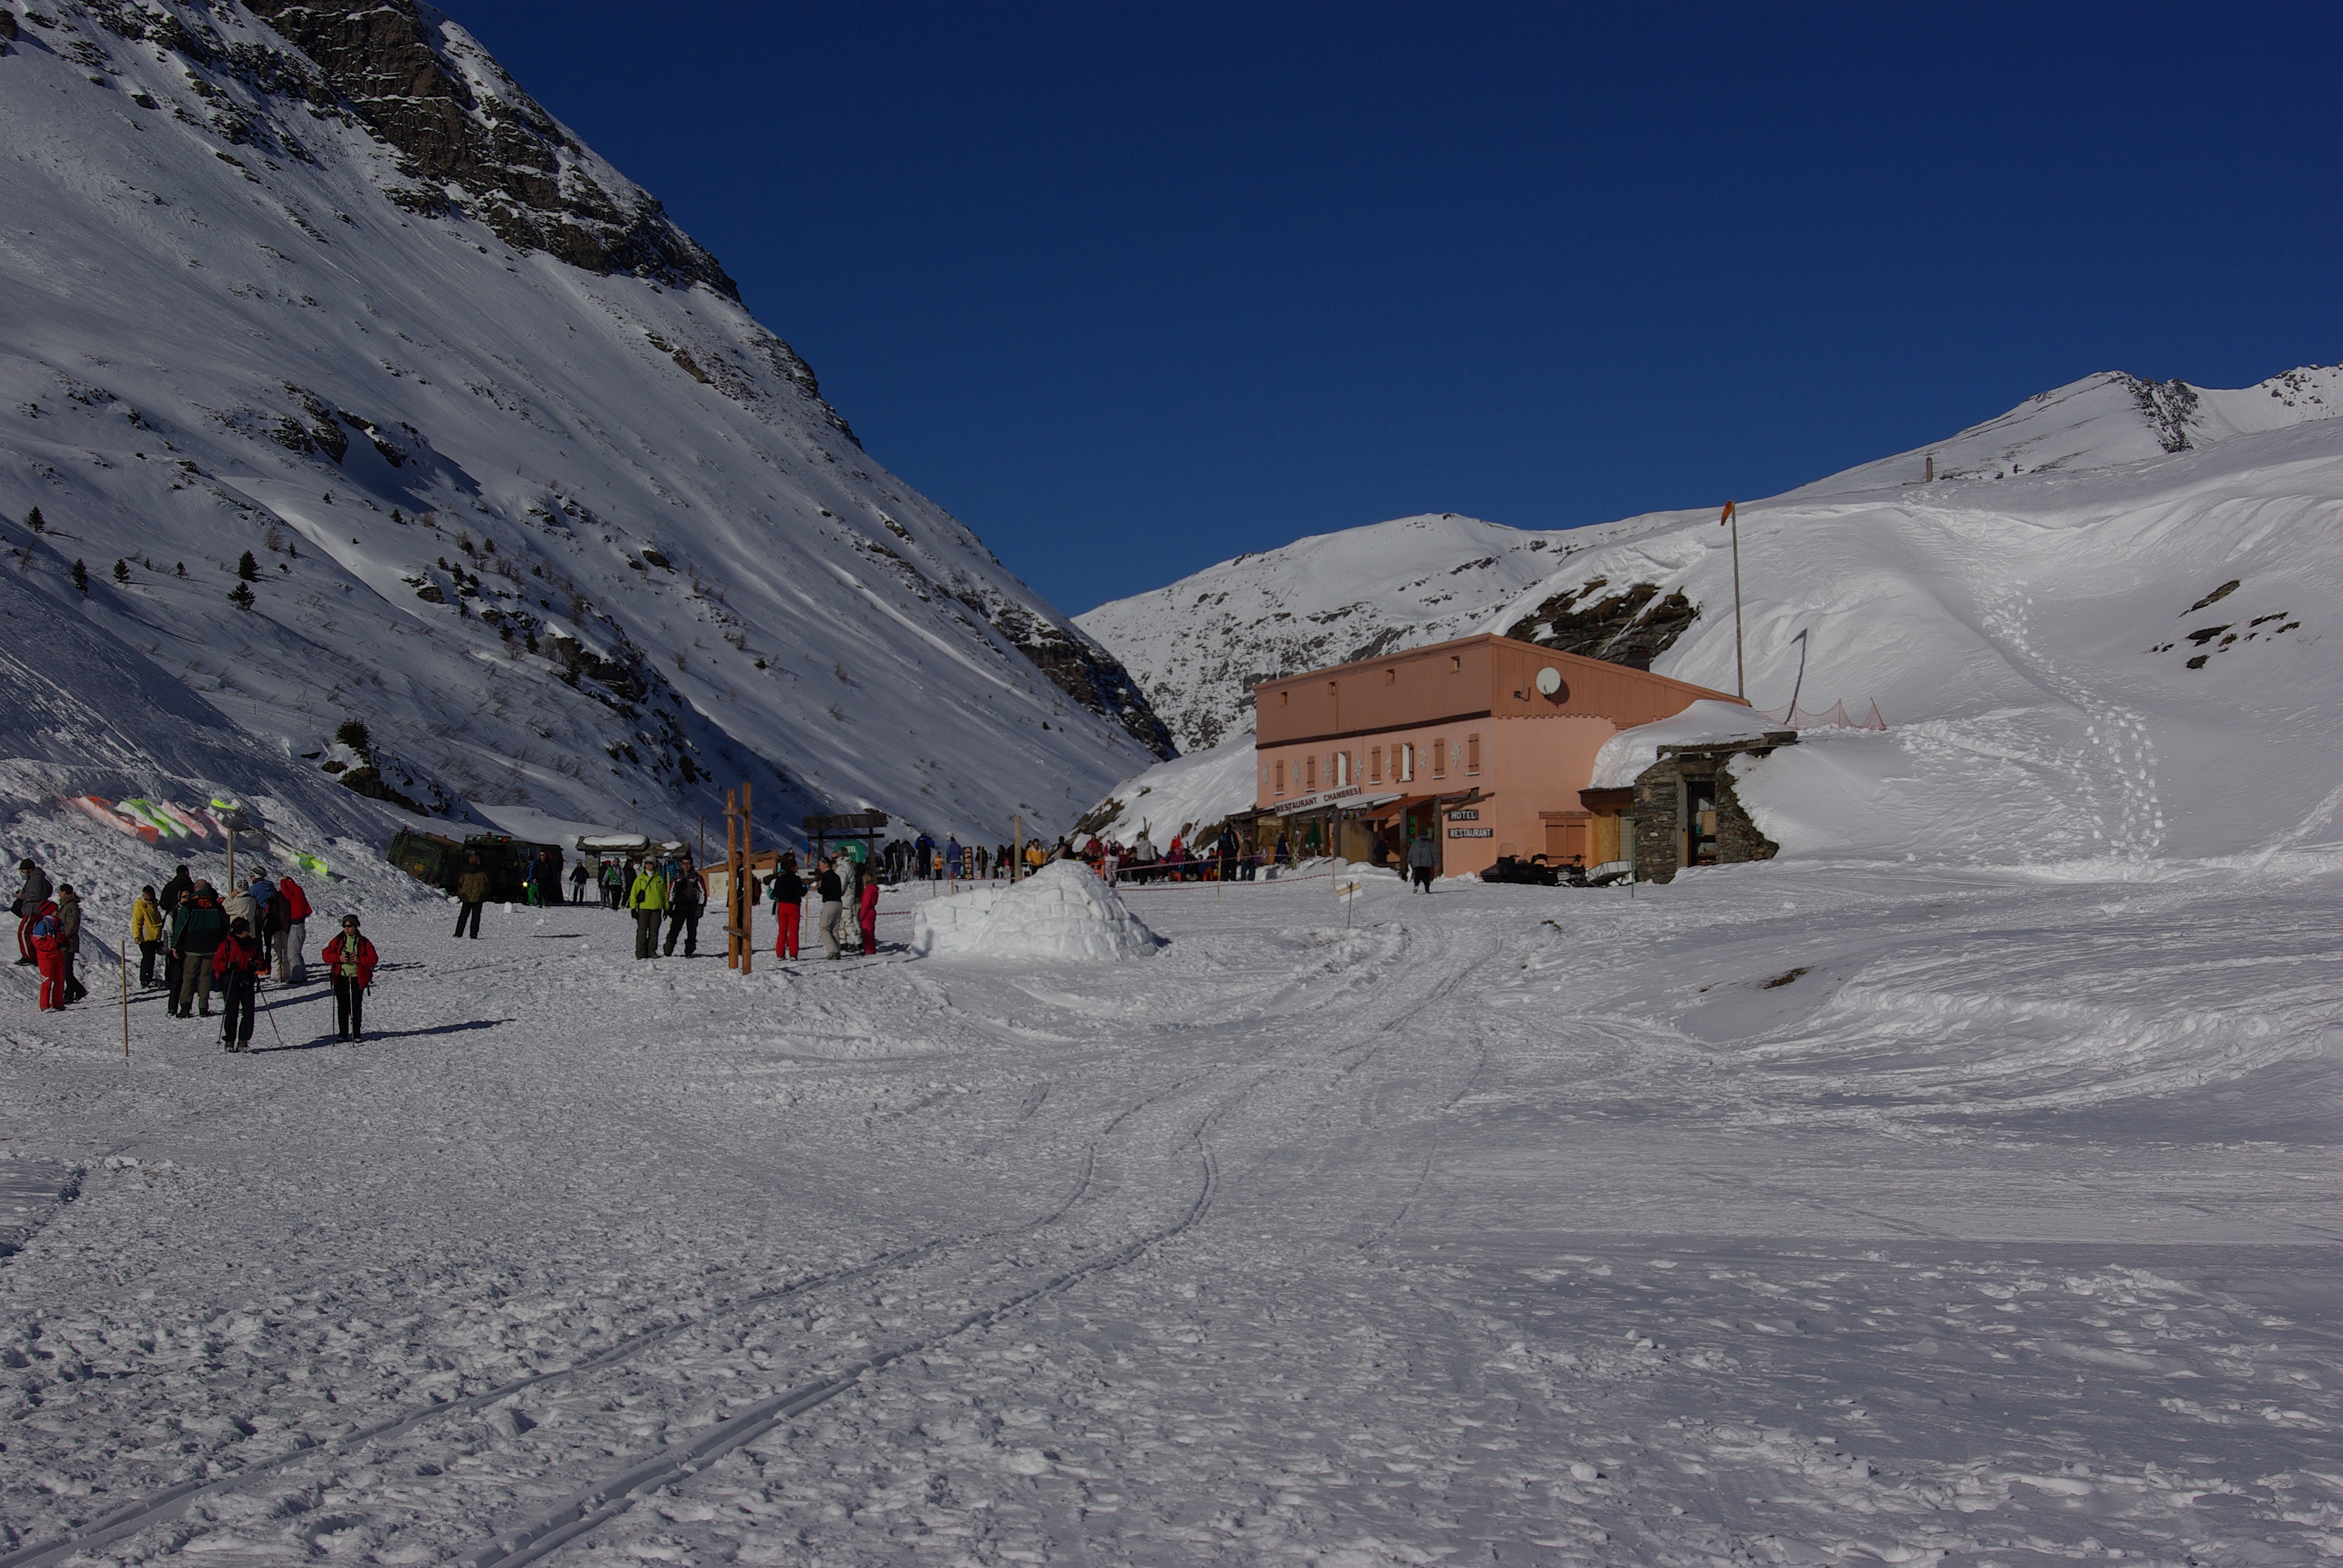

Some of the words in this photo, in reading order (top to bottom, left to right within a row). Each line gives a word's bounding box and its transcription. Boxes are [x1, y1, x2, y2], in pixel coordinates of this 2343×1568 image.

[1275, 797, 1317, 813] RESTAURANT
[1323, 787, 1359, 802] CHAMBRES
[1450, 811, 1476, 820] HOTEL
[1449, 828, 1492, 837] RESTAURANT
